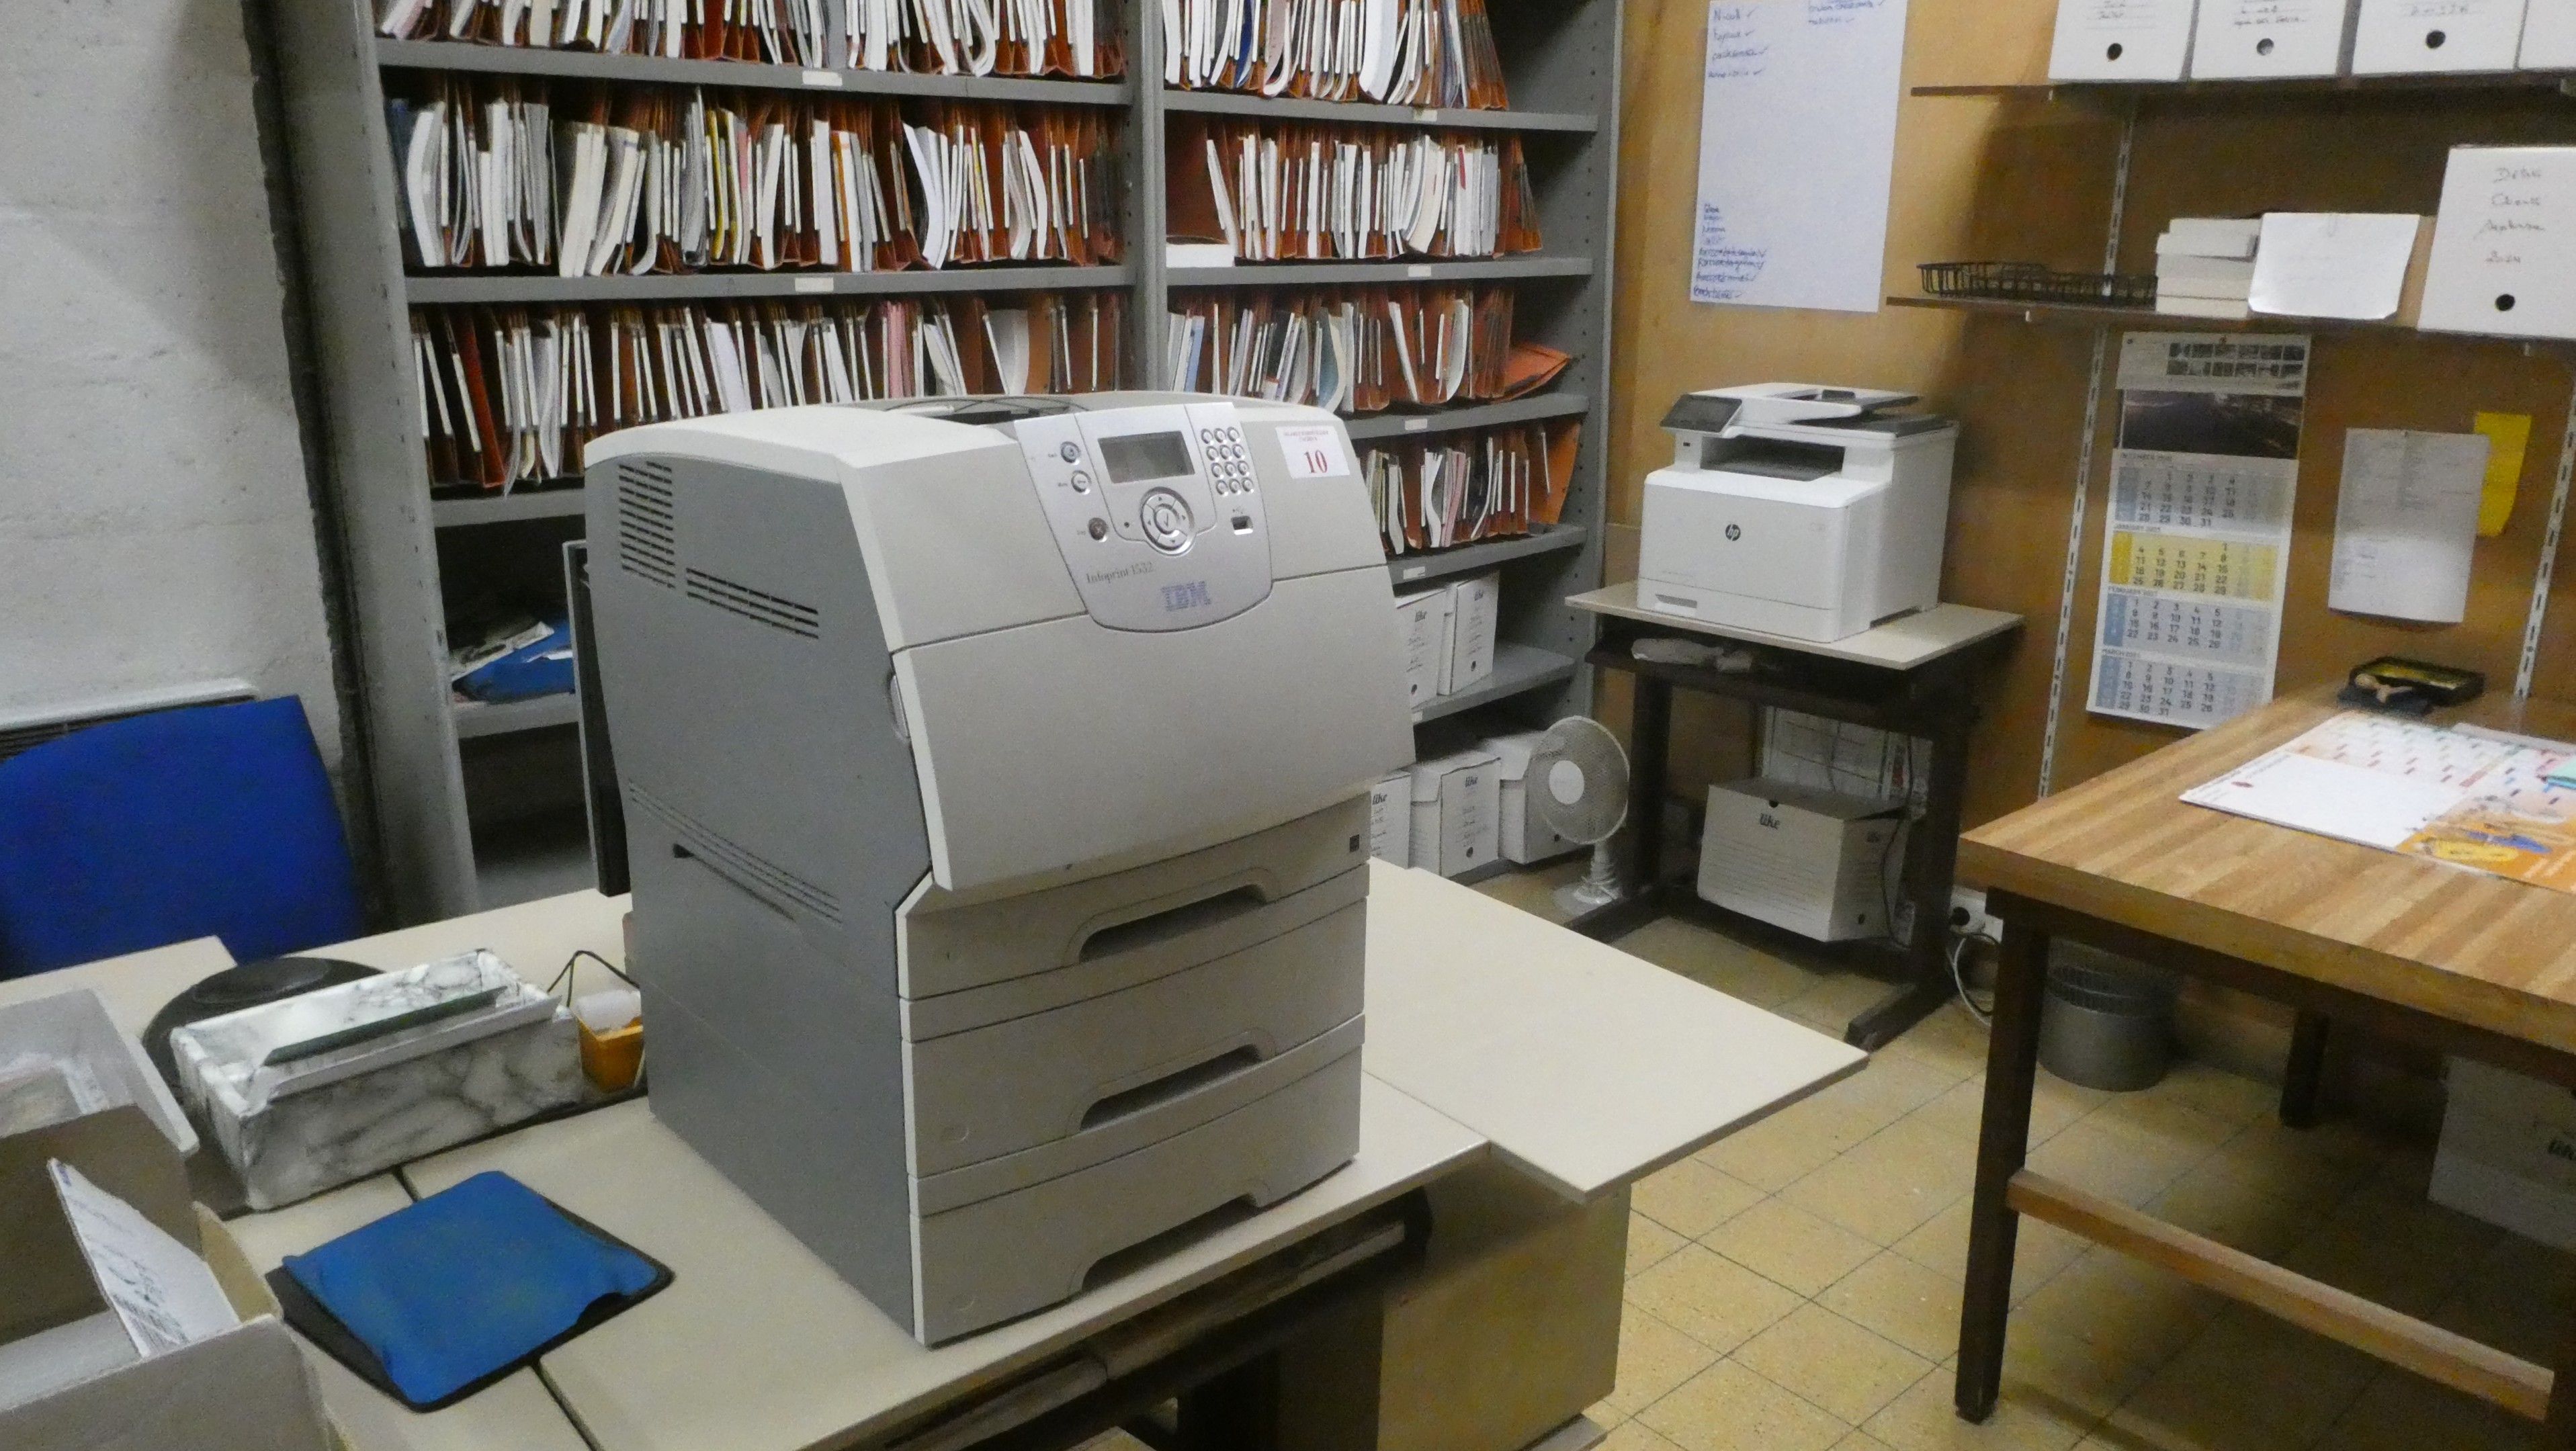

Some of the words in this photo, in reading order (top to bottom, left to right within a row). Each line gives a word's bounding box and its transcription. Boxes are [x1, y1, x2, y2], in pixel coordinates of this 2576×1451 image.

[1304, 449, 1328, 474] 10
[1726, 523, 1741, 541] hp
[1161, 581, 1211, 611] IBM
